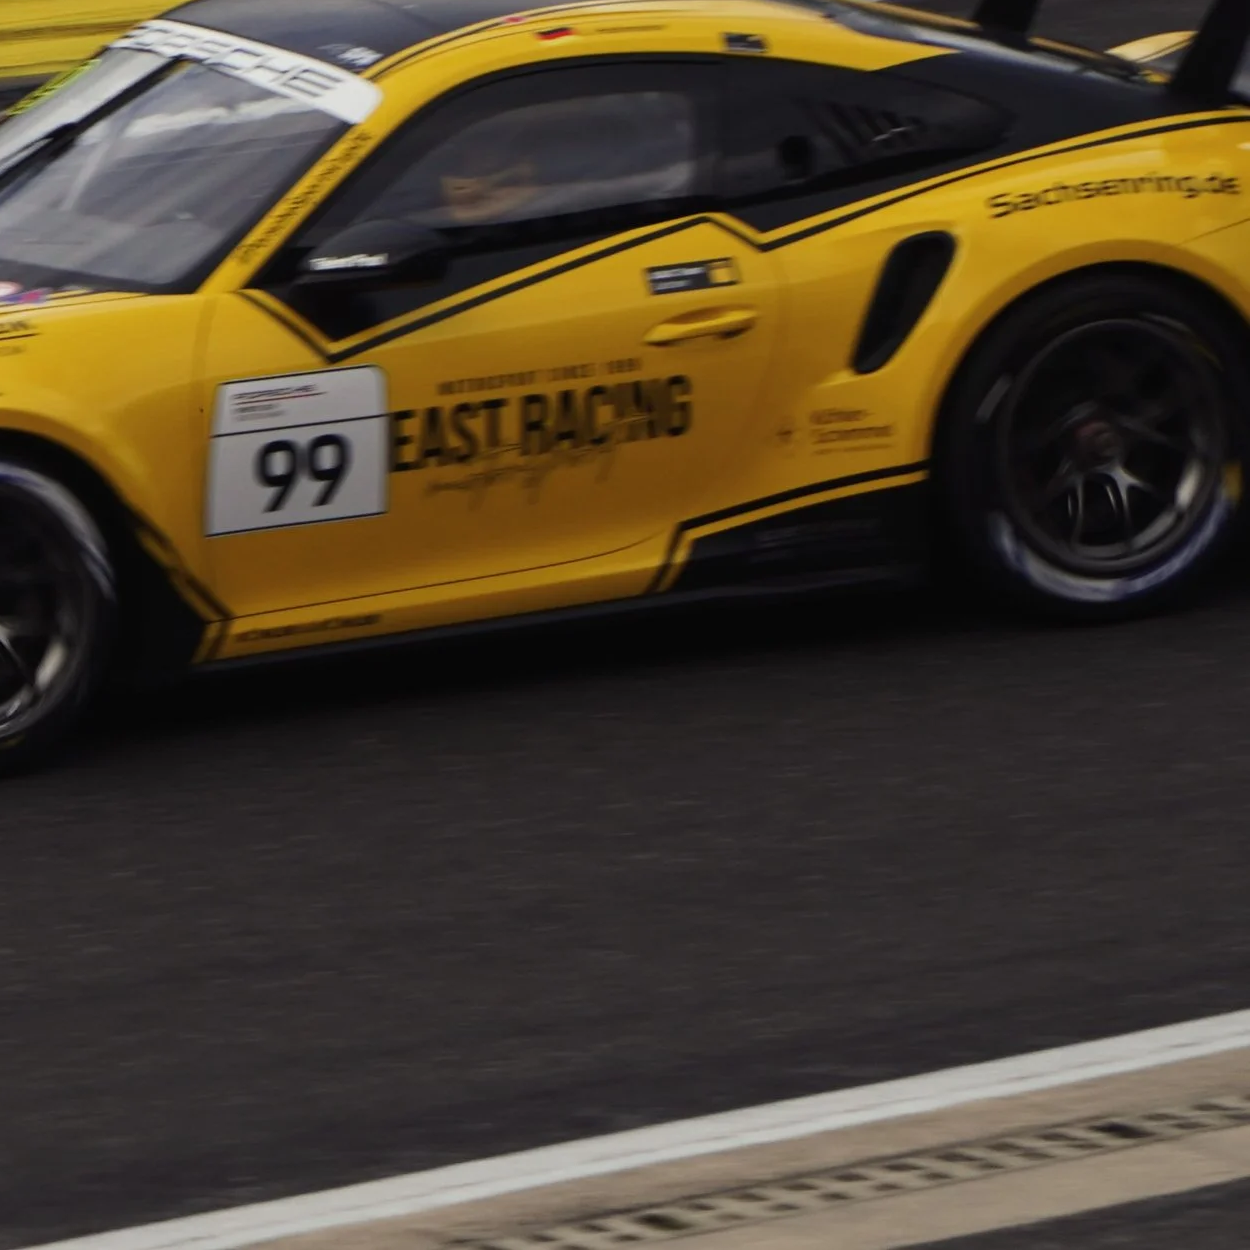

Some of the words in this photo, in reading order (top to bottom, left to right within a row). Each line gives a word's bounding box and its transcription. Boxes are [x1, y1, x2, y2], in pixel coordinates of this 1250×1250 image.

[386, 397, 510, 473] EAST
[518, 374, 693, 456] RACING
[252, 433, 352, 514] 99
